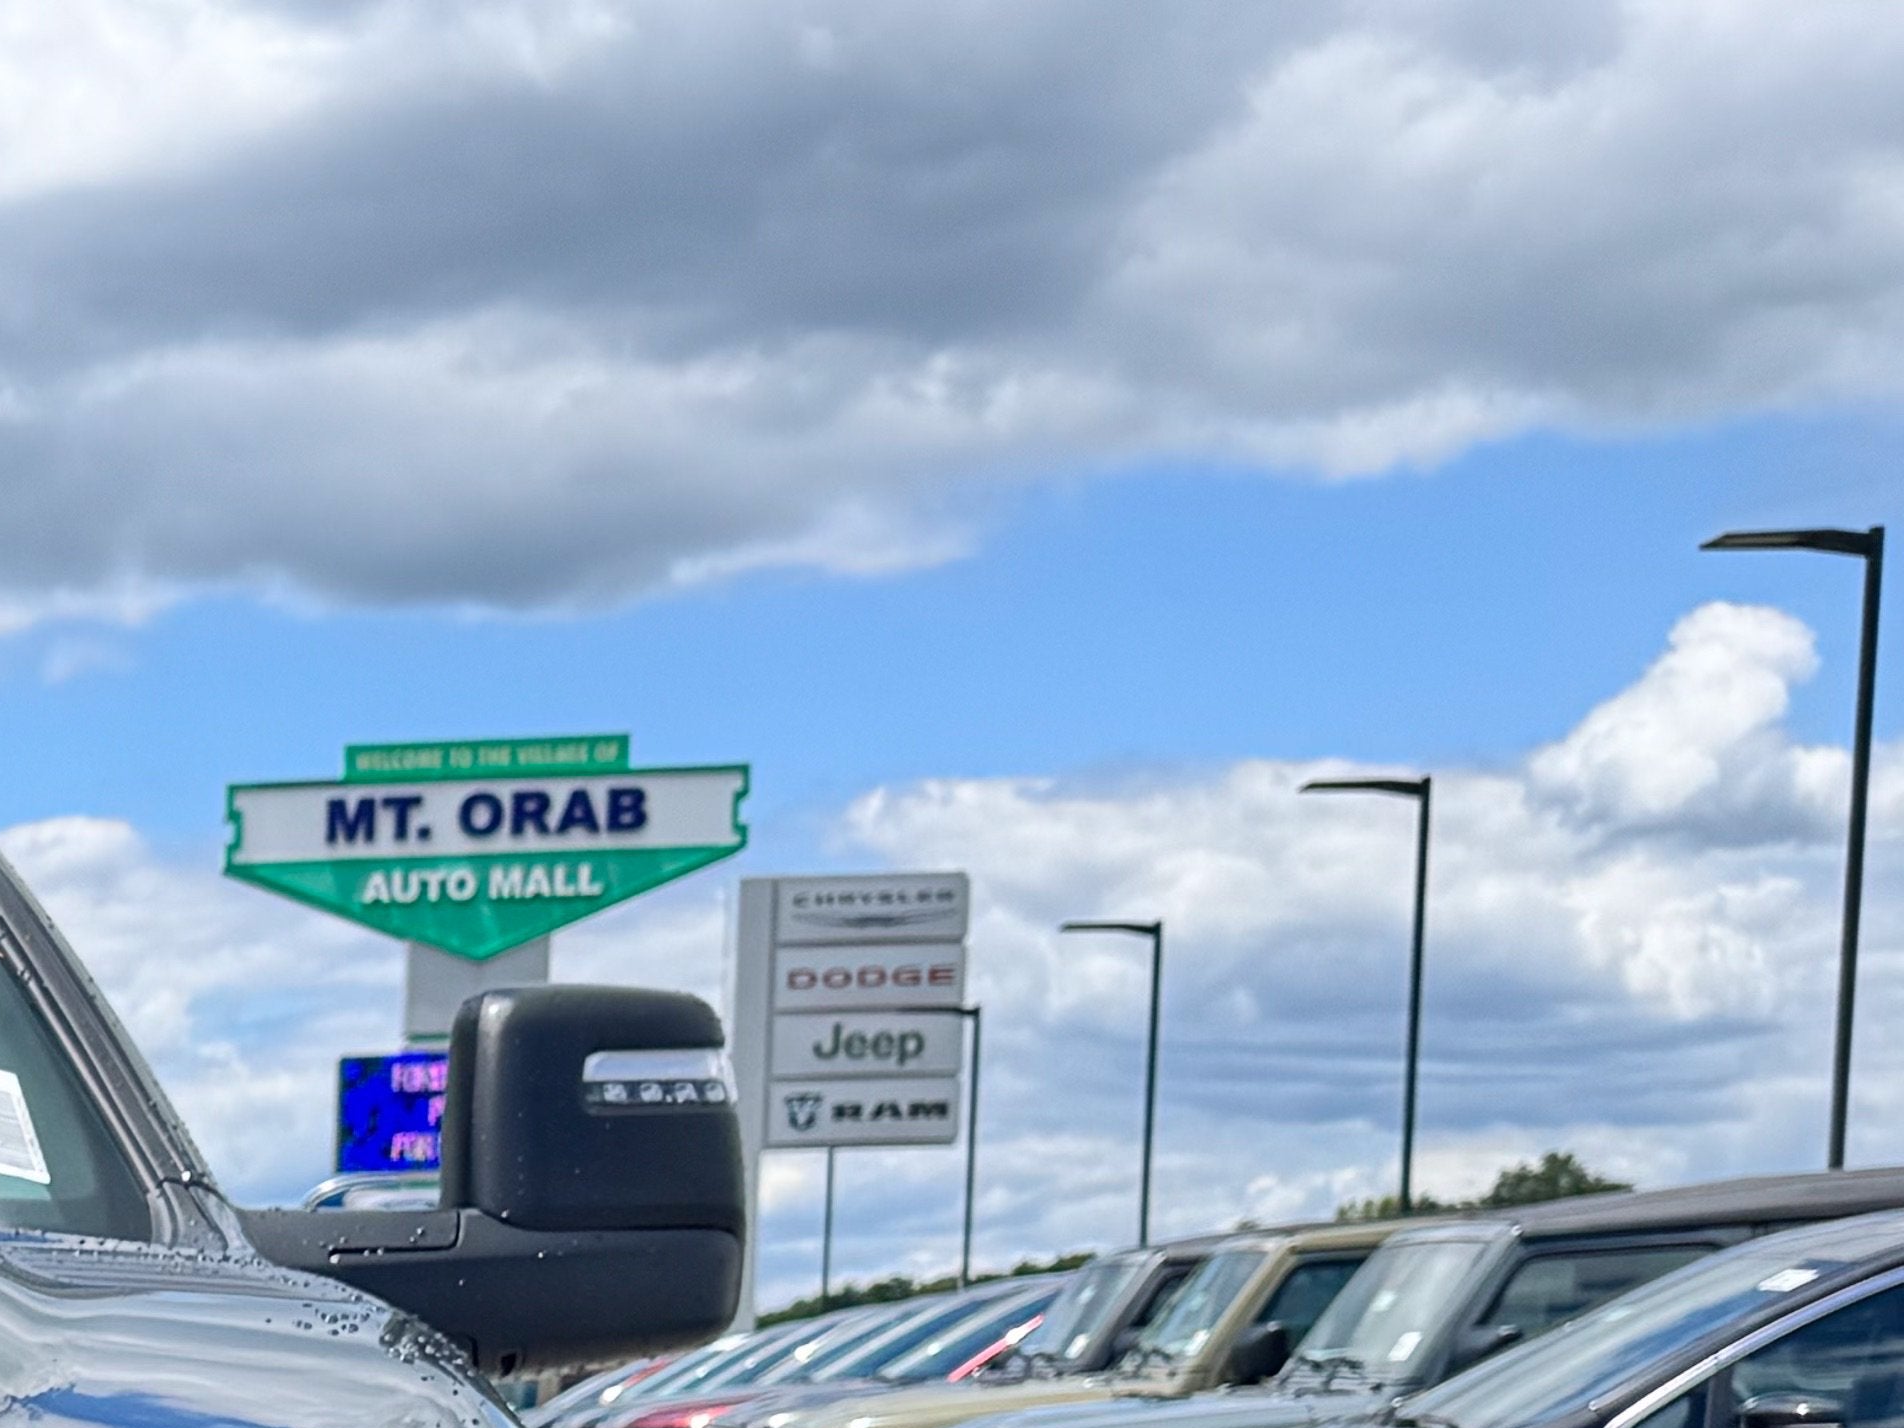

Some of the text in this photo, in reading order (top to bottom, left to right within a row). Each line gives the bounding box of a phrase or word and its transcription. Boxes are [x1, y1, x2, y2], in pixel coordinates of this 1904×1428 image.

[355, 740, 620, 771] WELCOME TO THE VILLAGE OF
[325, 787, 649, 845] MT. ORAB
[361, 861, 604, 905] AUTO MALL
[792, 888, 956, 908] CHRYSLER
[787, 962, 956, 991] DODGE
[812, 1021, 925, 1067] Jeep
[831, 1101, 949, 1121] RAM
